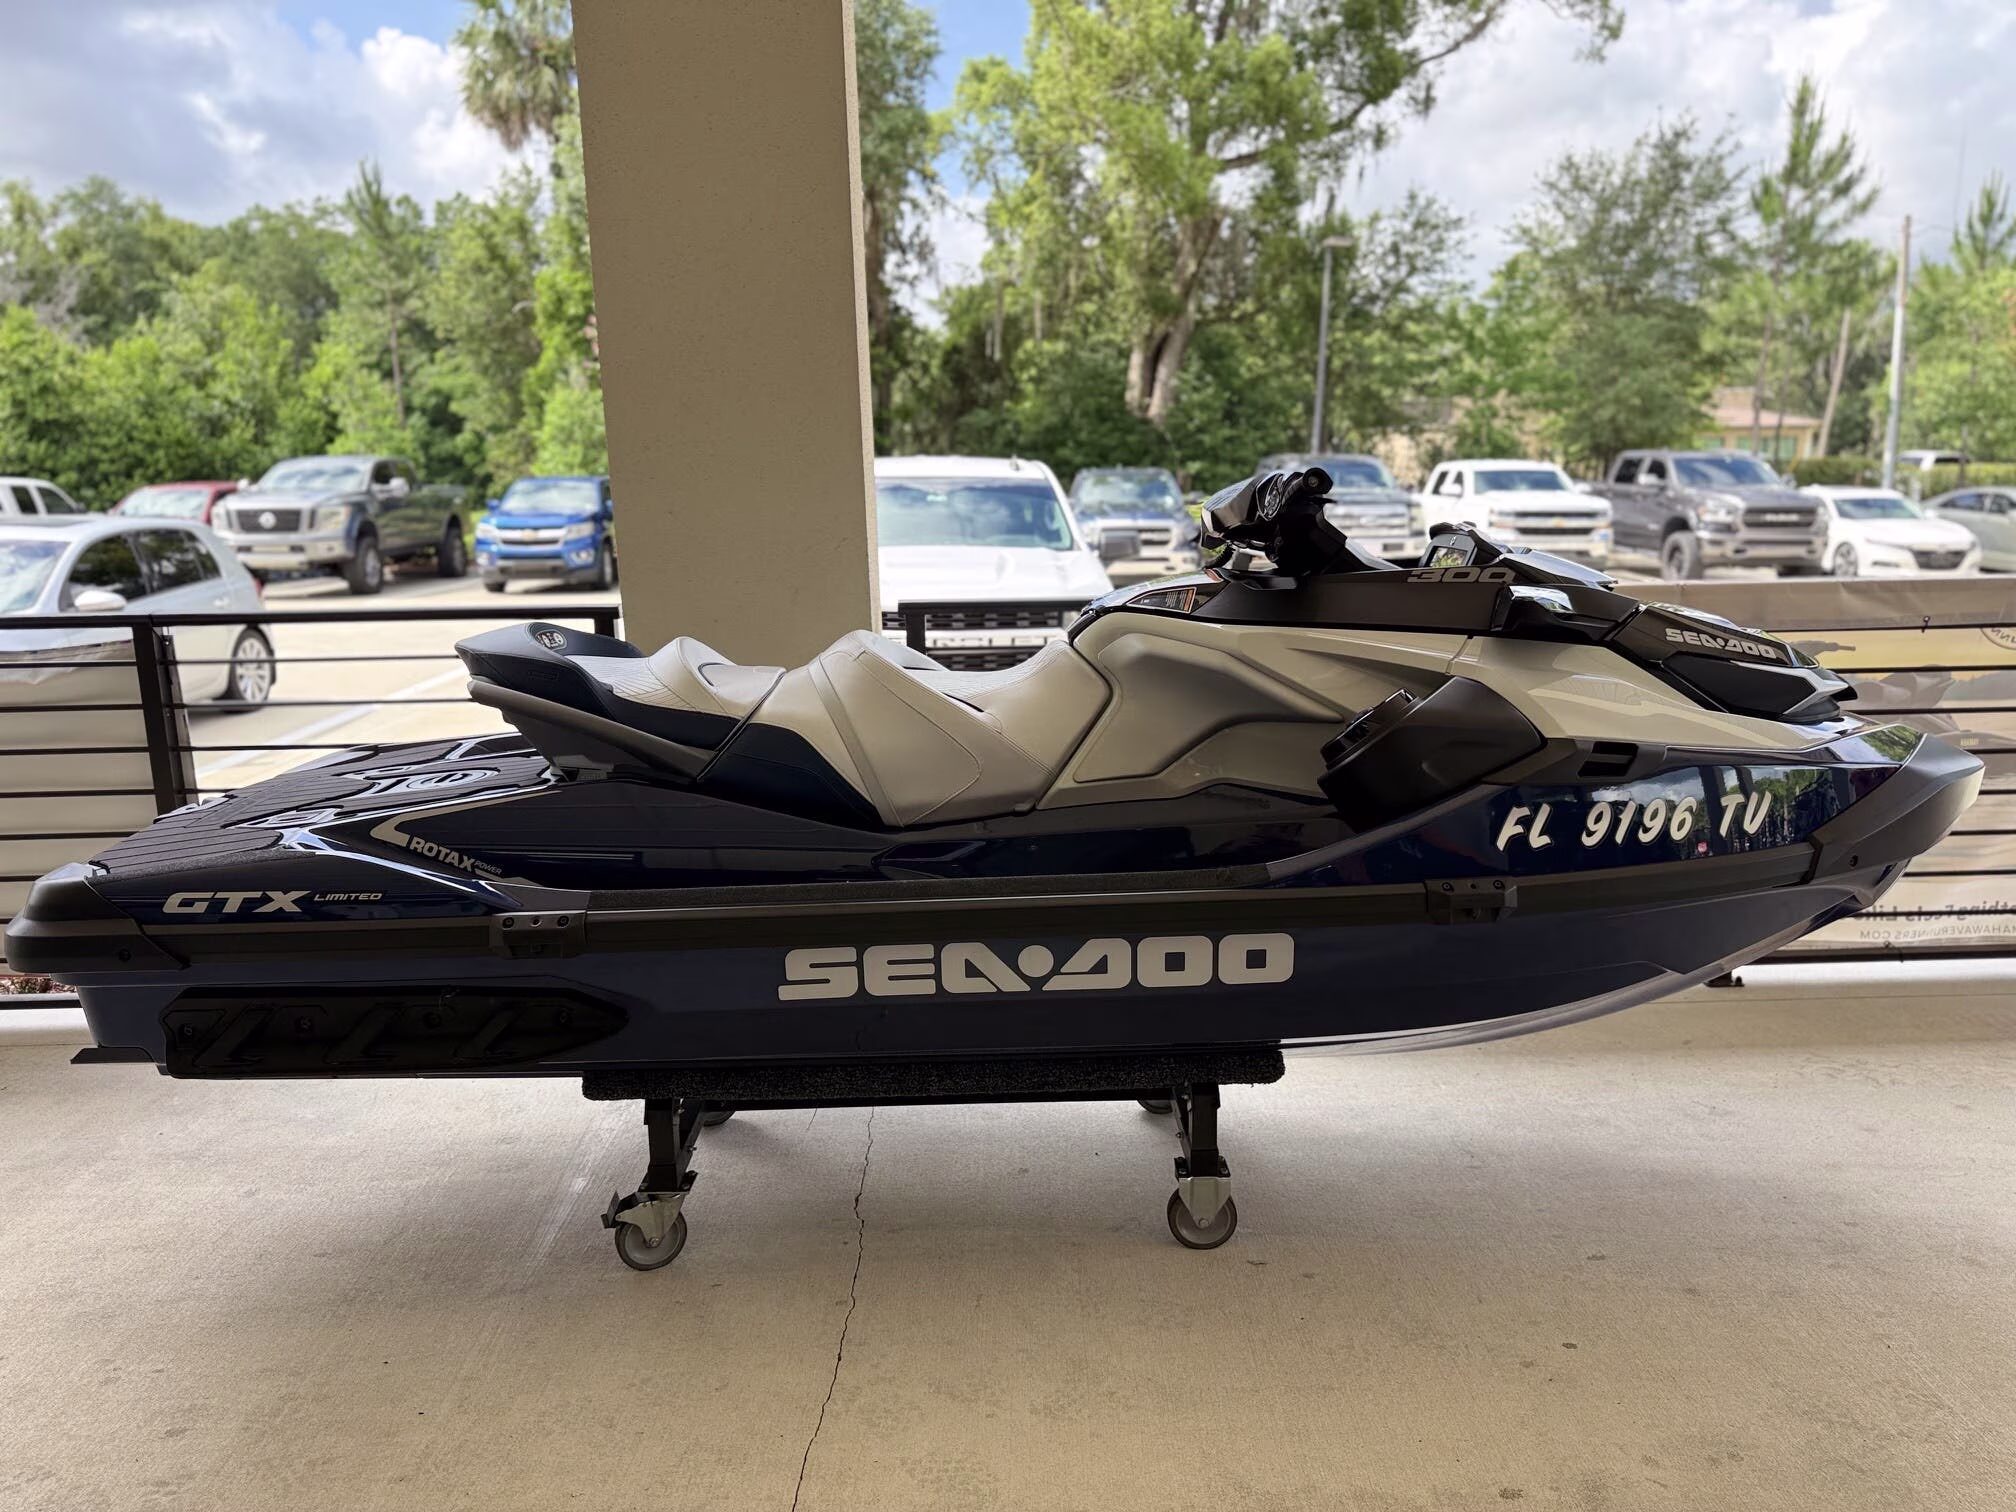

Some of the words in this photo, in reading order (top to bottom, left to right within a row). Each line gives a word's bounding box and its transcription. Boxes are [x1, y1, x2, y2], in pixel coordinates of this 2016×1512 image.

[1407, 567, 1516, 583] 300
[1496, 803, 1552, 851] FL
[1582, 796, 1697, 848] 9196
[409, 836, 475, 872] ROTAX
[474, 860, 502, 875] POWER
[162, 891, 311, 913] GTX
[313, 893, 382, 901] LIMITED
